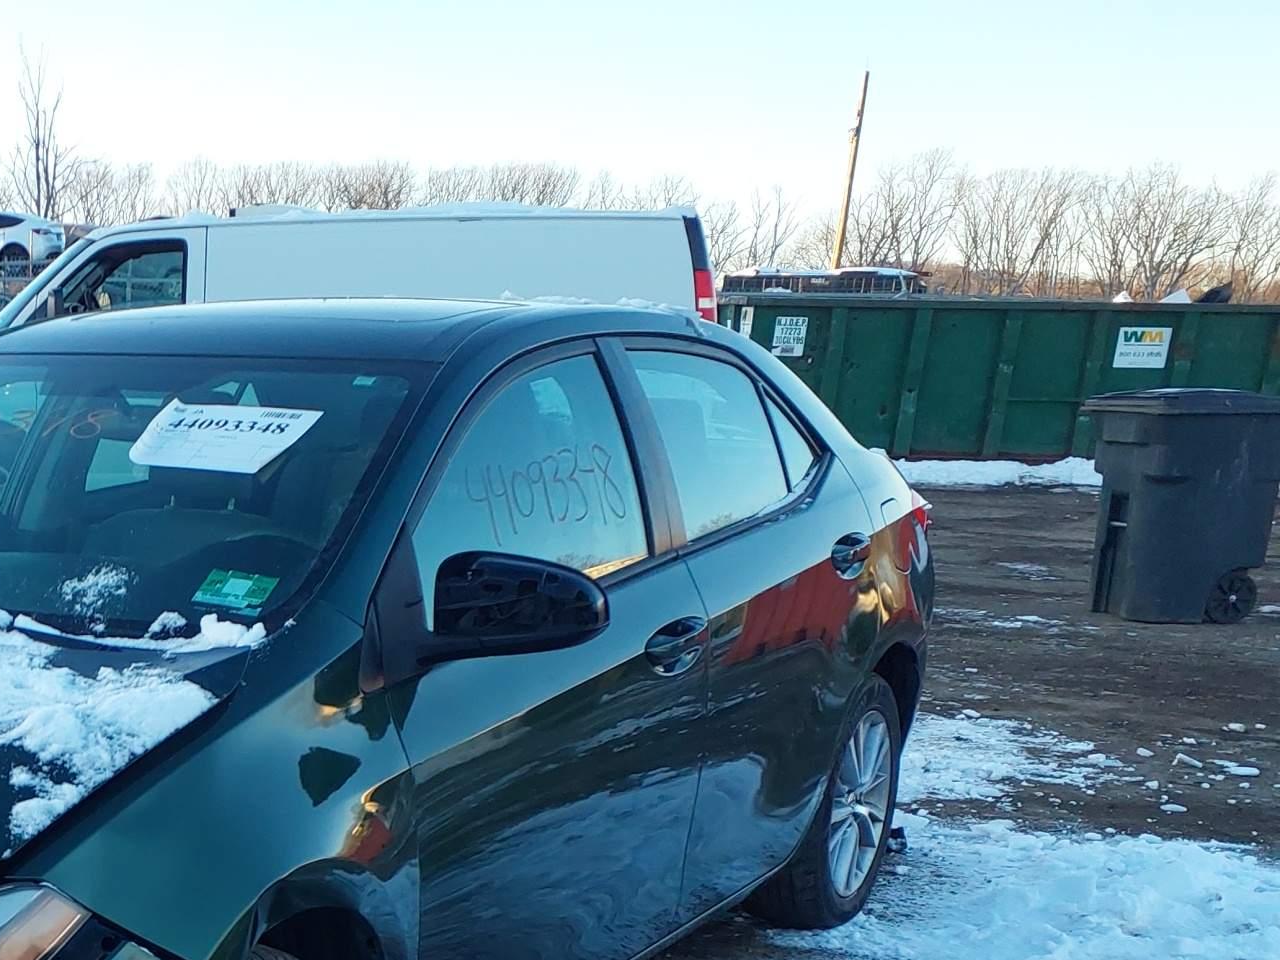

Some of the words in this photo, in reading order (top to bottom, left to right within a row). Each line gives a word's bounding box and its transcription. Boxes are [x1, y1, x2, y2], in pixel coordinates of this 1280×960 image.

[780, 327, 802, 336] 17273
[1123, 330, 1164, 342] WM
[168, 416, 290, 435] 44093348
[465, 443, 626, 547] 44093348
